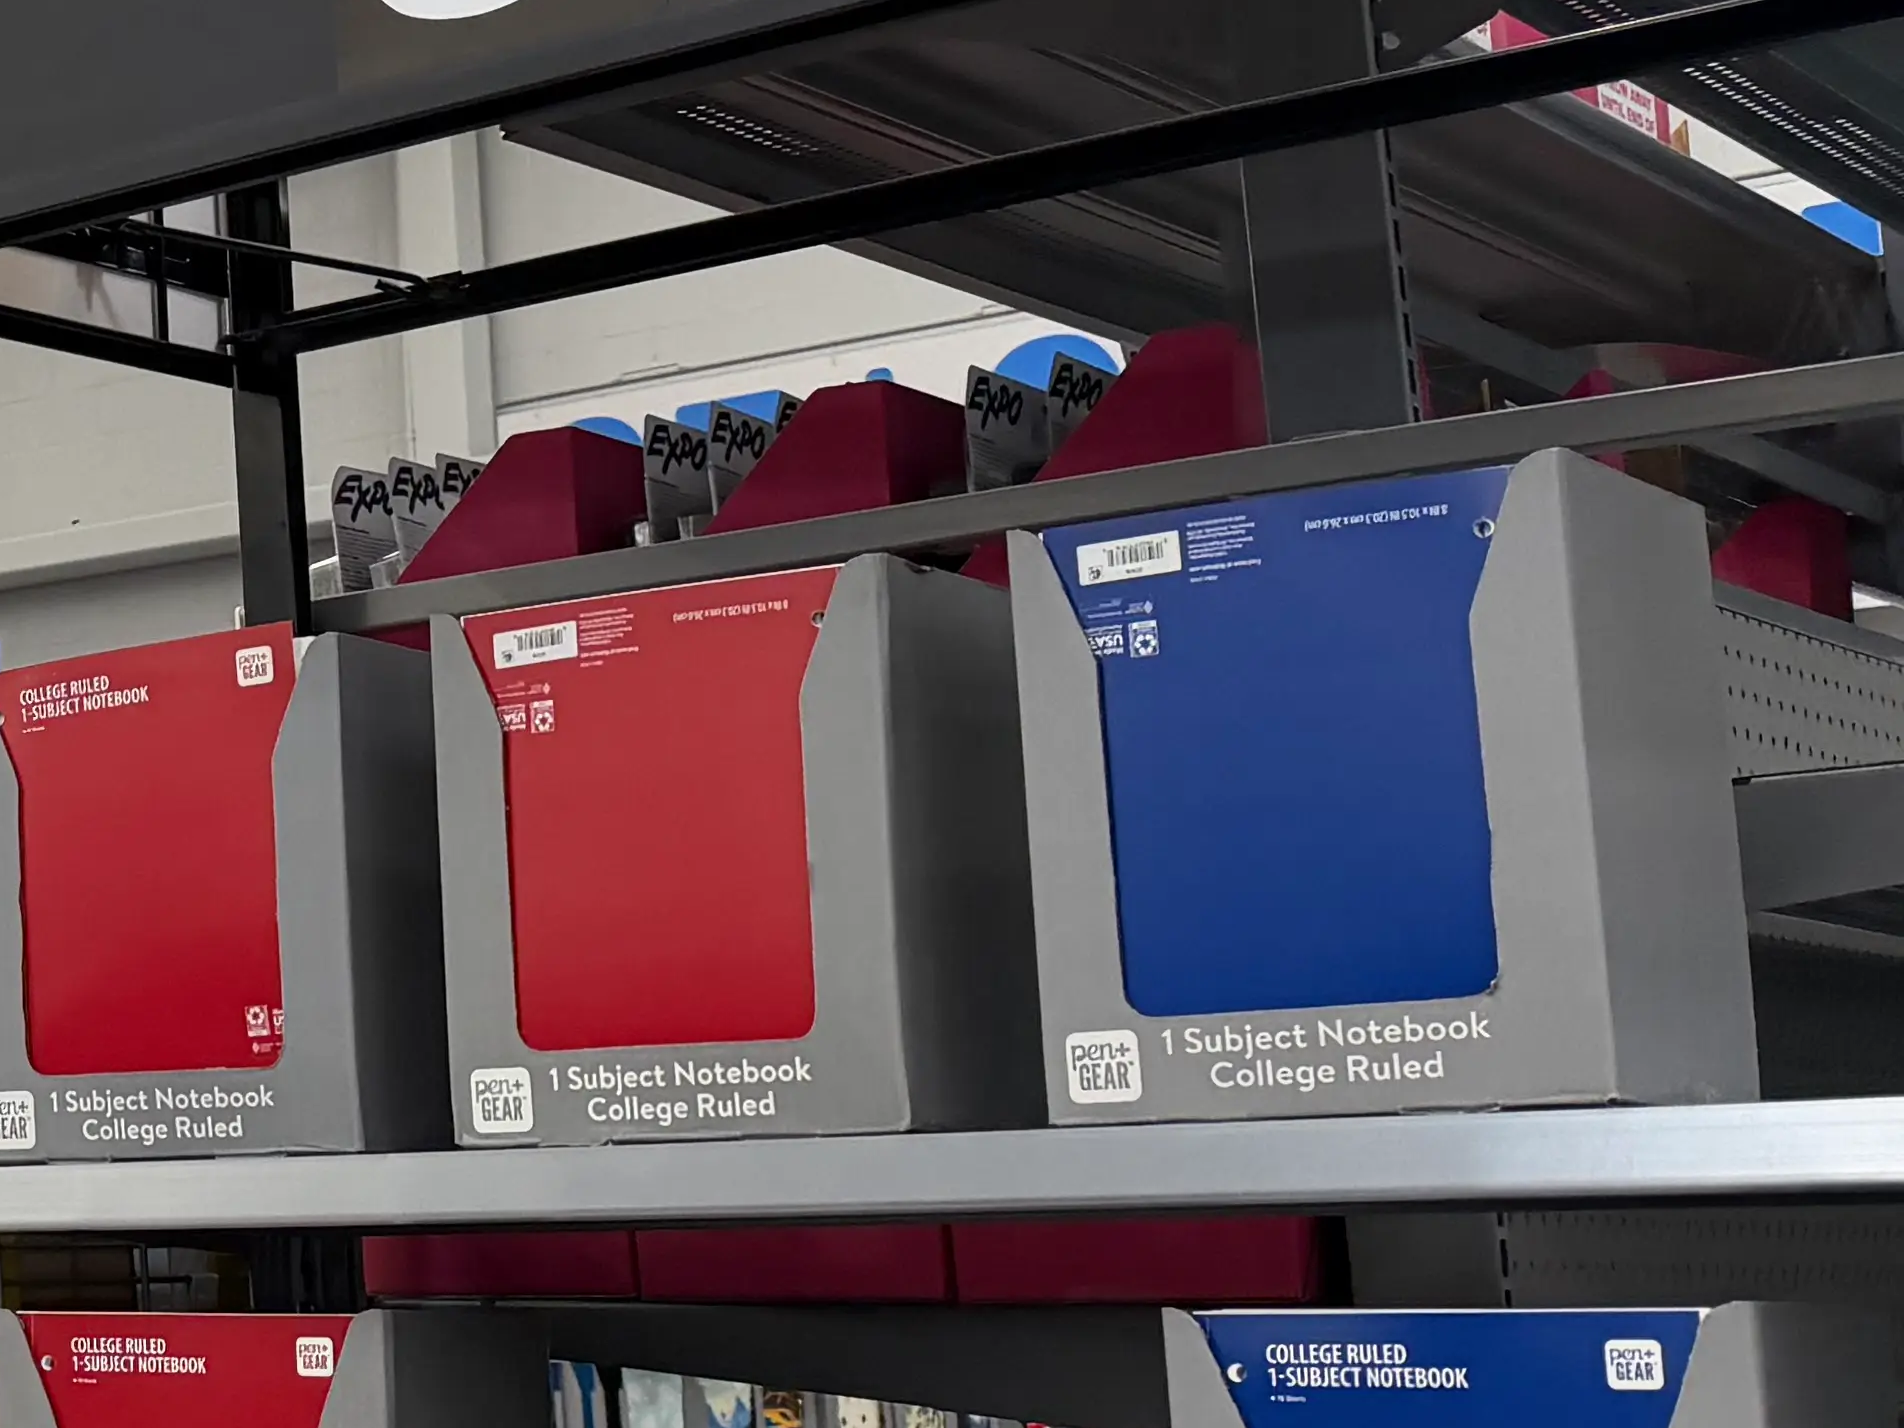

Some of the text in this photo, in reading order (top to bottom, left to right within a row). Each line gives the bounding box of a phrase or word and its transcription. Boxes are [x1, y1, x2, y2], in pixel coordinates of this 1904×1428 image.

[968, 375, 1023, 427] EXPO
[646, 422, 709, 474] EXPO
[19, 675, 110, 708] COLLEGE RULED
[20, 684, 149, 725] 1-SUBJECT NOTEBOOK
[1161, 1011, 1491, 1057] 1 Subject Notebook
[550, 1056, 812, 1096] 1 Subject Notebook
[1078, 1060, 1135, 1093] GEAR
[1210, 1052, 1445, 1092] College Ruled
[49, 1082, 275, 1118] 1 Subject Notebook
[480, 1092, 529, 1123] GEAR
[587, 1091, 776, 1129] College Ruled
[81, 1115, 244, 1147] College Ruled
[1266, 1345, 1407, 1365] COLLEGE RULED
[1268, 1366, 1469, 1389] 1-SUBJECT NOTEBOOK
